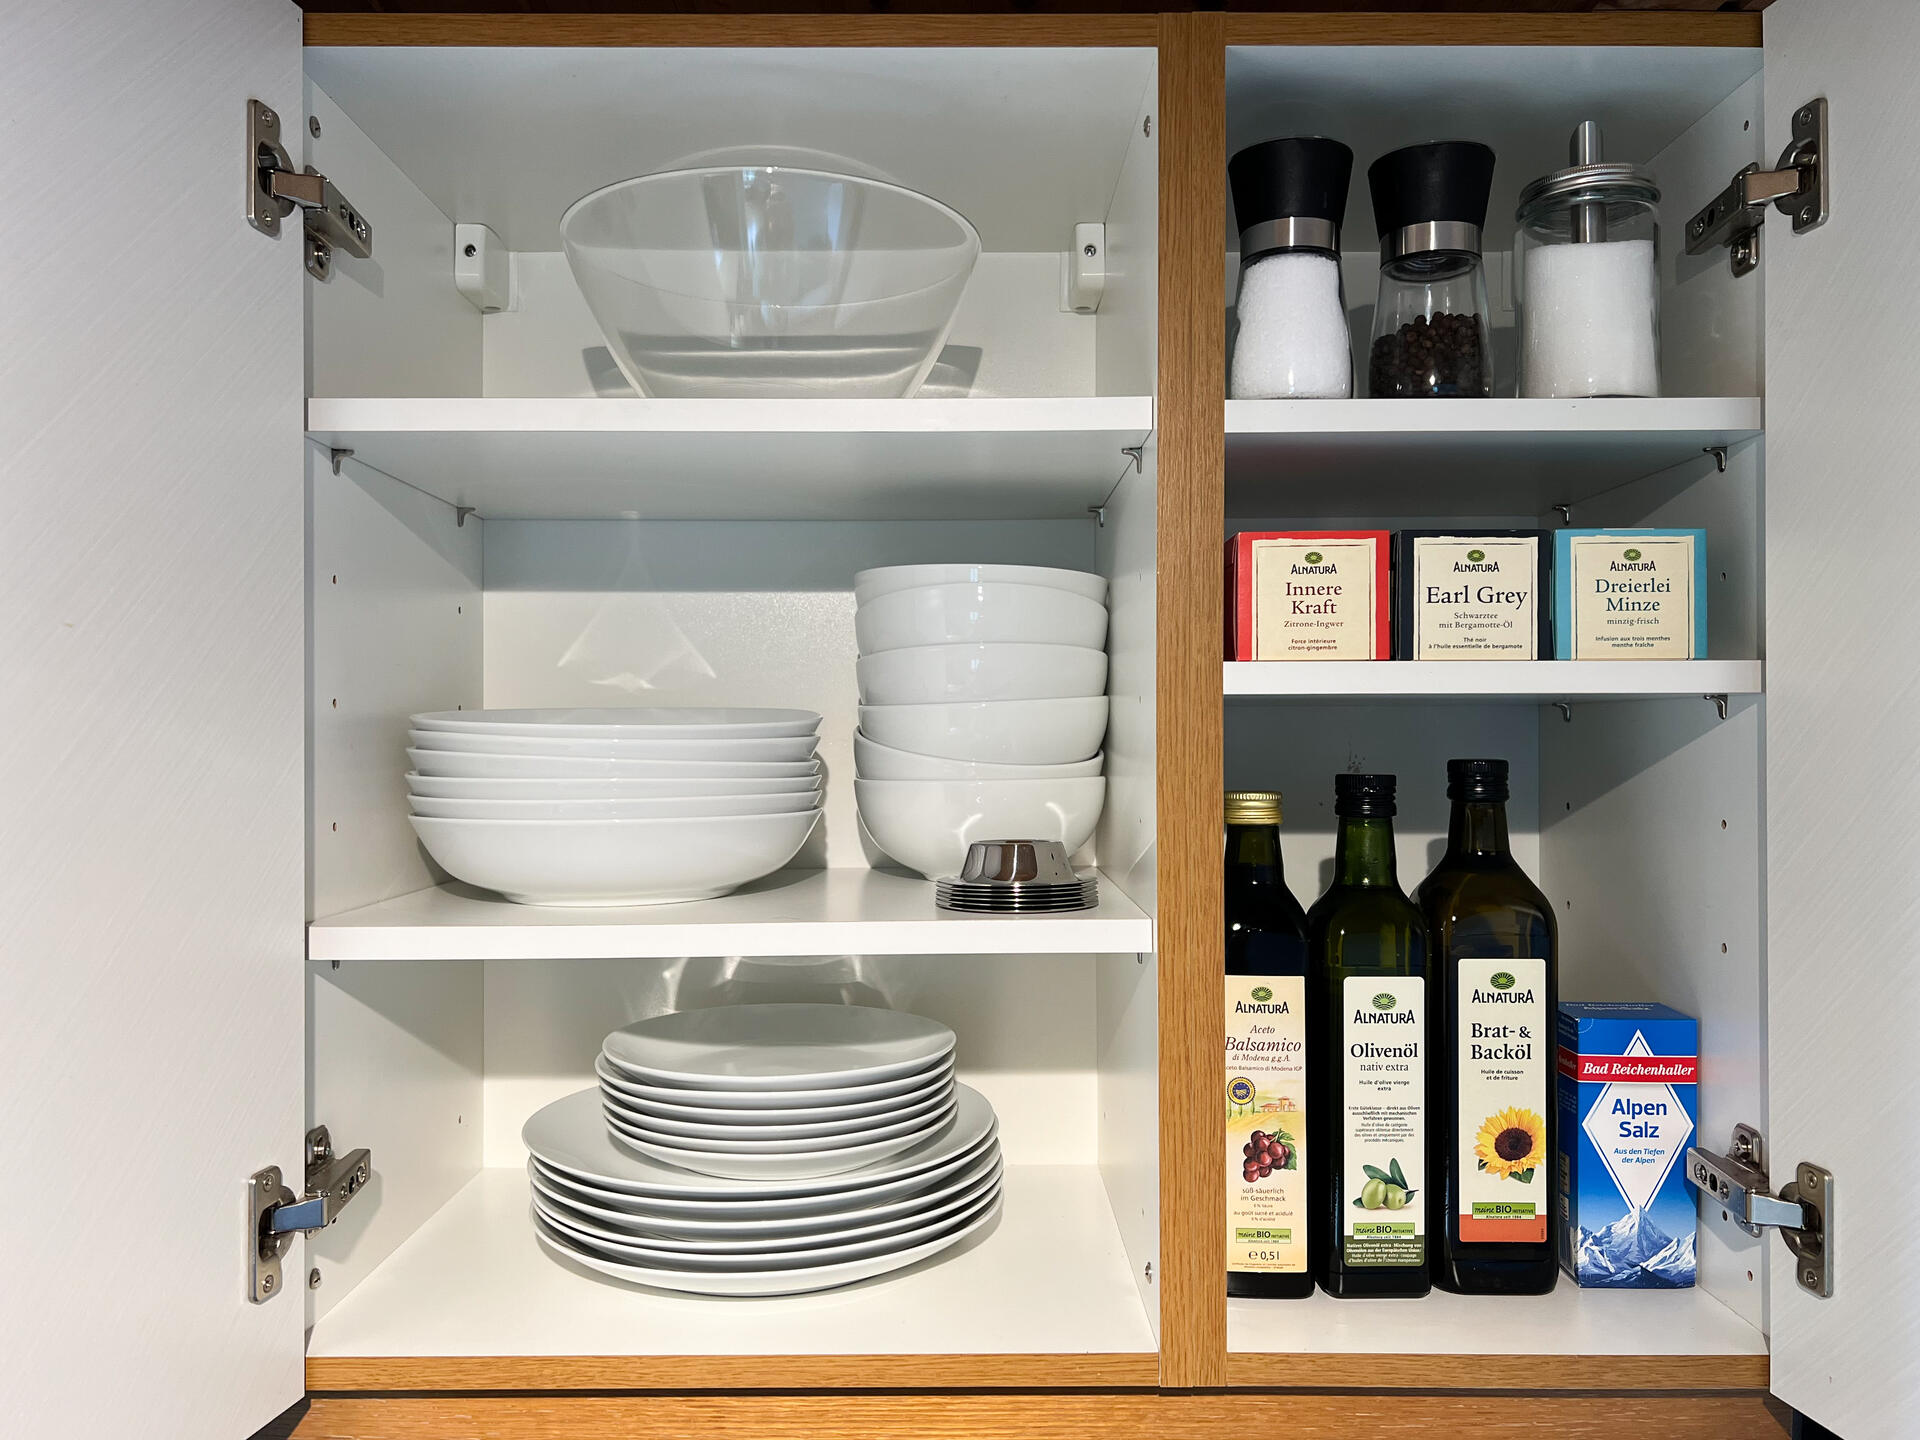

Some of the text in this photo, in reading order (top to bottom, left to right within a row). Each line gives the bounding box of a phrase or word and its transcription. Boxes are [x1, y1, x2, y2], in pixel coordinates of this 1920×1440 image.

[1291, 563, 1338, 574] ALNATURA
[1453, 561, 1500, 573] ALNATURA
[1610, 560, 1656, 572] ALNATURA
[1286, 582, 1342, 596] Innere
[1595, 578, 1671, 593] Dreierlei
[1426, 585, 1528, 610] Earl Grey
[1606, 597, 1660, 612] Minze
[1292, 599, 1337, 614] Kraft
[1284, 620, 1344, 629] Zitrone-Ingwer
[1455, 620, 1513, 630] Bergamotte-Öl
[1607, 617, 1660, 626] minzig-frisch
[1472, 989, 1534, 1003] ALNATURA
[1235, 1000, 1289, 1014] ALNATURA
[1354, 1009, 1415, 1024] ALNATURA
[1250, 1024, 1275, 1034] Aceto
[1471, 1023, 1531, 1038] Brat- &
[1226, 1036, 1302, 1052] Balsamico
[1351, 1043, 1418, 1058] Olivenöl
[1471, 1044, 1531, 1060] Backöl
[1360, 1062, 1383, 1071] nativ
[1583, 1063, 1694, 1075] Bad Reichenhaller
[1612, 1098, 1667, 1119] Alpen
[1619, 1121, 1659, 1138] Salz
[1260, 1251, 1275, 1261] 0,5
